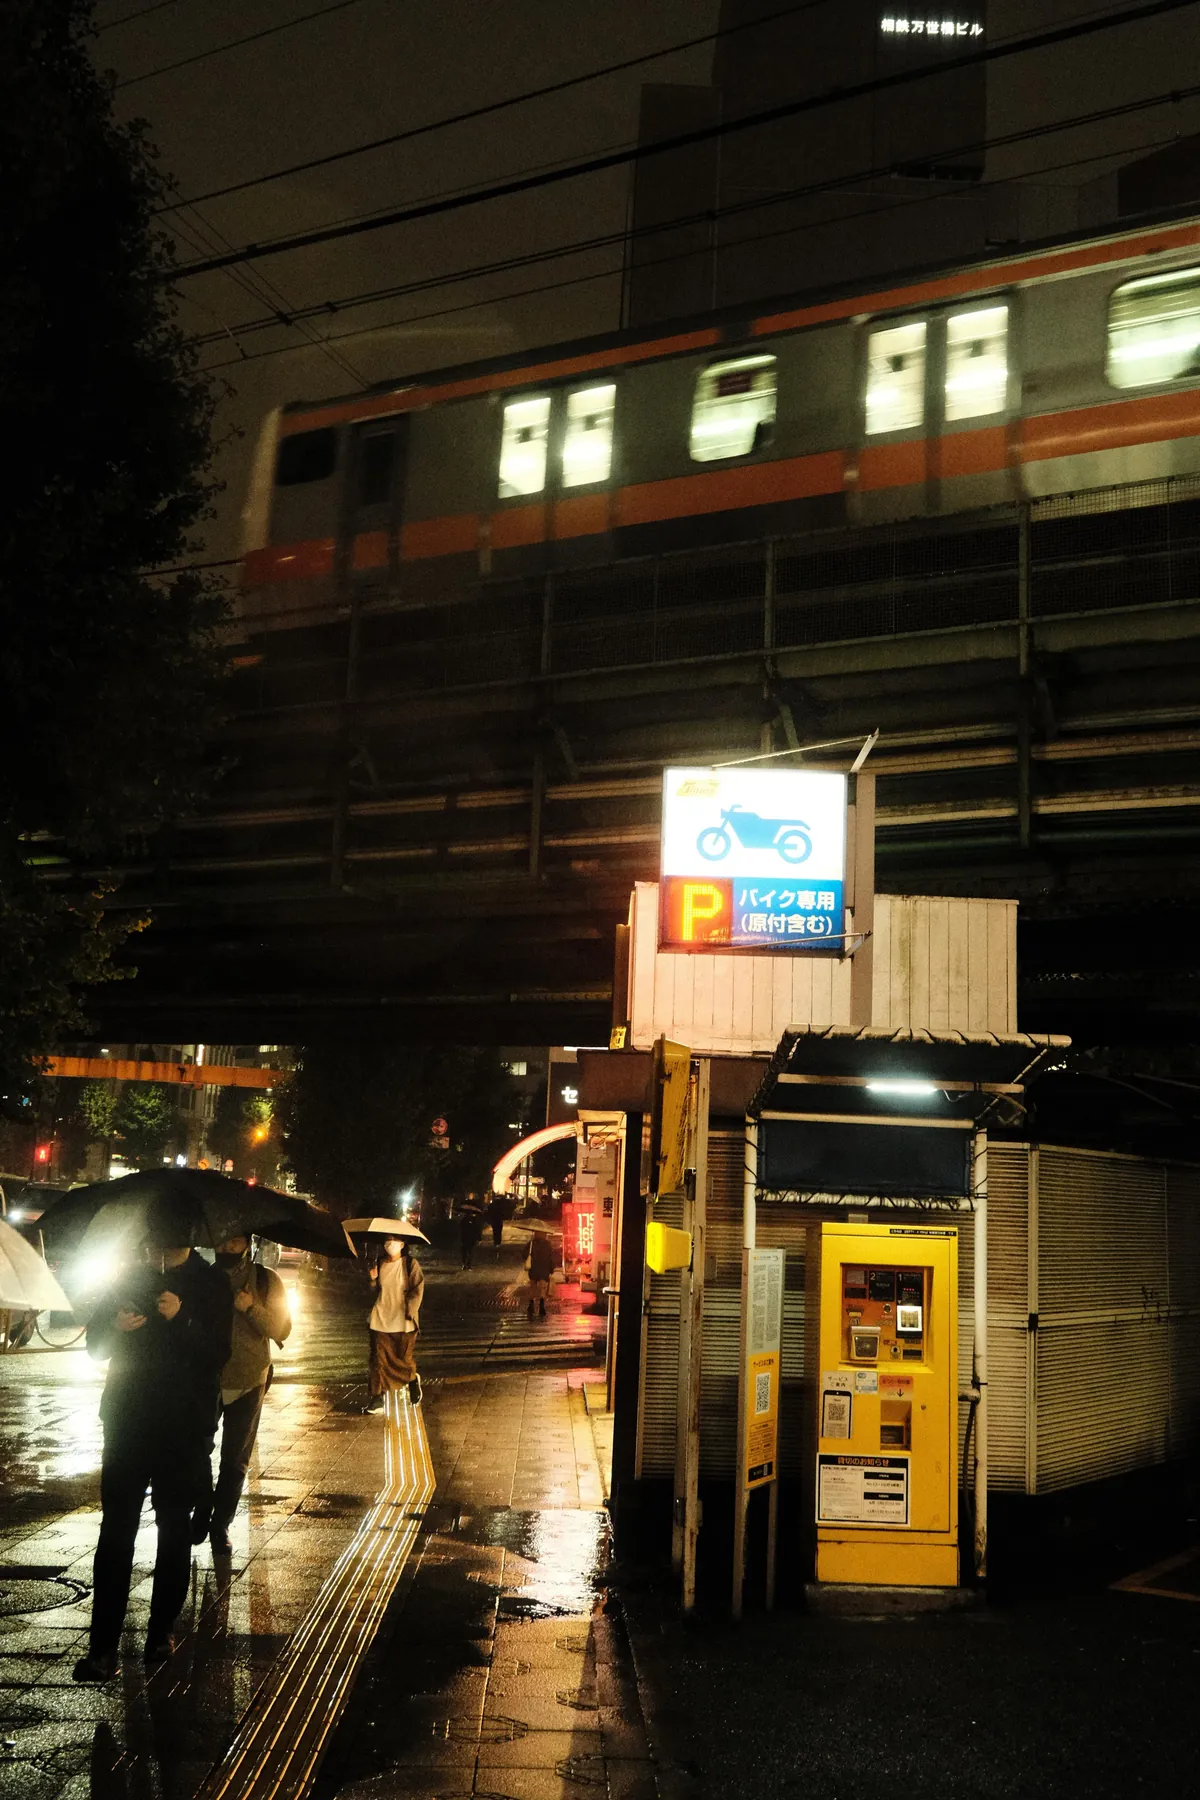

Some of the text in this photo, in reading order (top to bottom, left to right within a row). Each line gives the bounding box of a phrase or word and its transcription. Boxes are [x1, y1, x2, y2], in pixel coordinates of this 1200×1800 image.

[881, 19, 984, 36] 相鉄万世橋ビル
[739, 888, 835, 911] バイク専用
[682, 884, 723, 941] P
[741, 913, 833, 935] (原付含む)
[870, 1272, 876, 1281] 2
[898, 1273, 902, 1281] 1
[837, 1456, 889, 1467] 貸切のお知らせ
